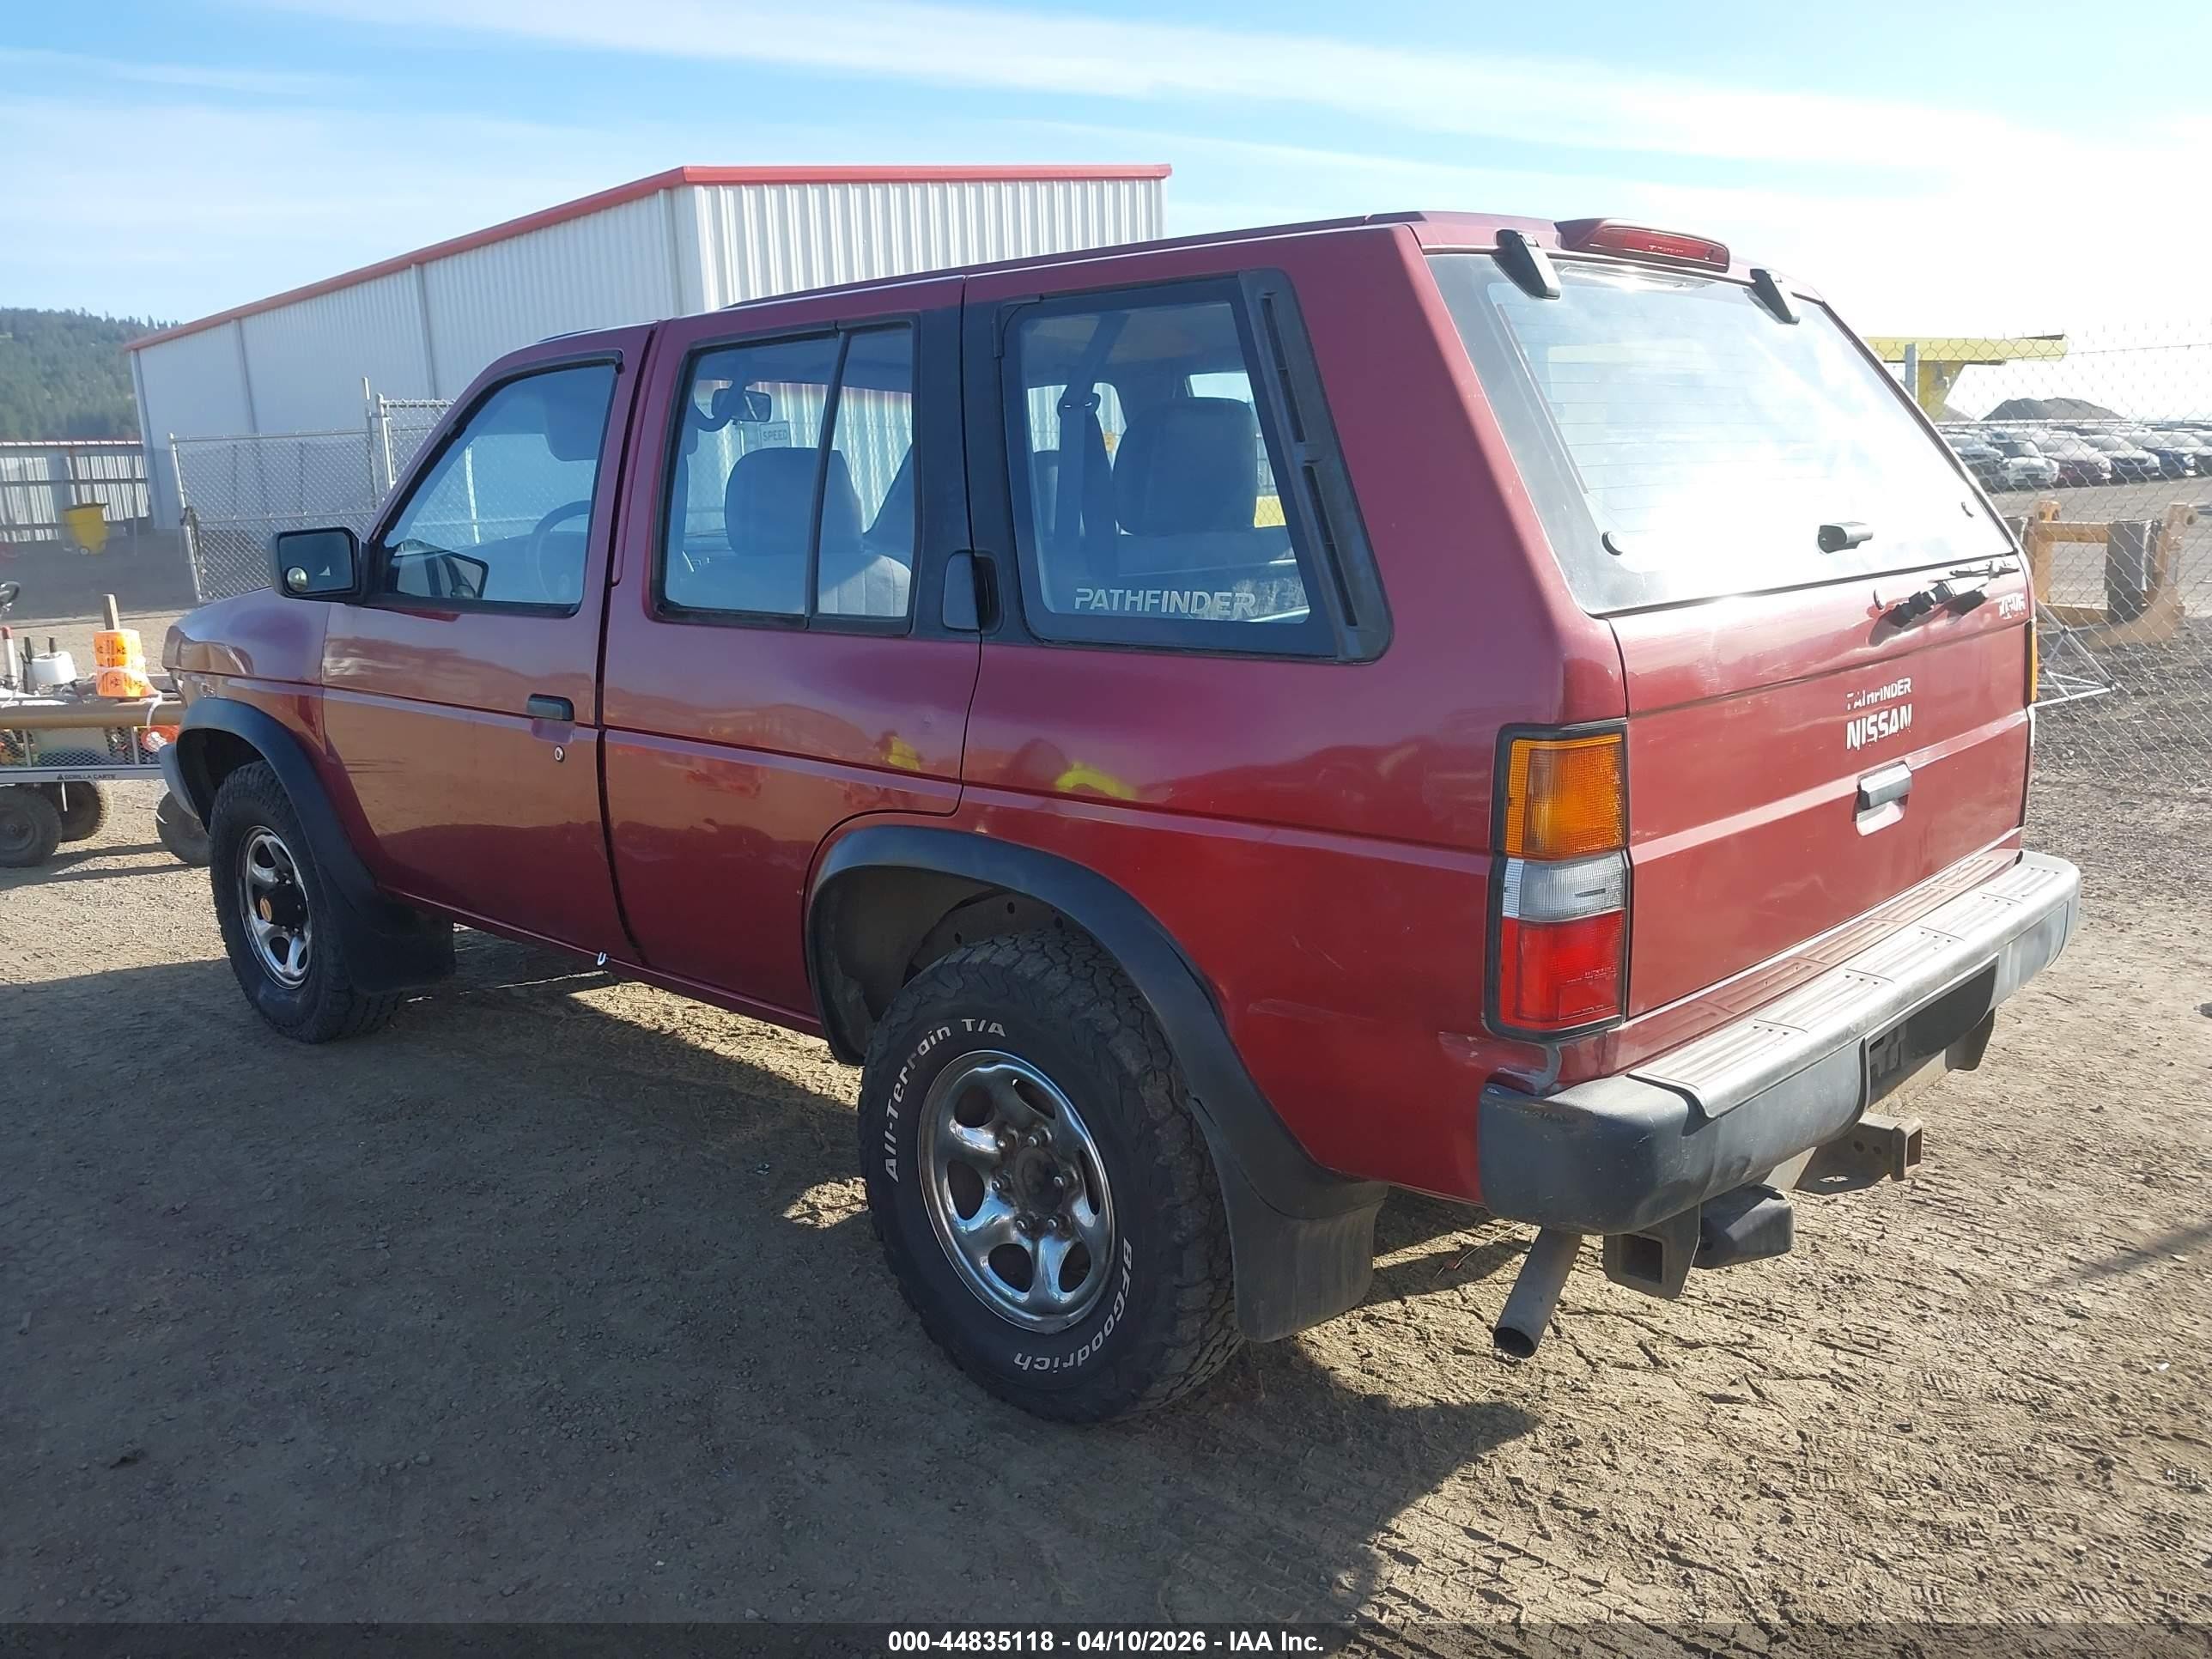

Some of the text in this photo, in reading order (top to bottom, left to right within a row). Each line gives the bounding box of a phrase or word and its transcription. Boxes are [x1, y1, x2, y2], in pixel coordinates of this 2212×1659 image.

[763, 429, 788, 441] SPEED
[1074, 587, 1258, 617] PATHFINDER
[1846, 703, 1912, 750] NISSAN
[885, 1018, 1006, 1182] All-Terrain T/A
[1013, 1237, 1133, 1374] BFGoodrich
